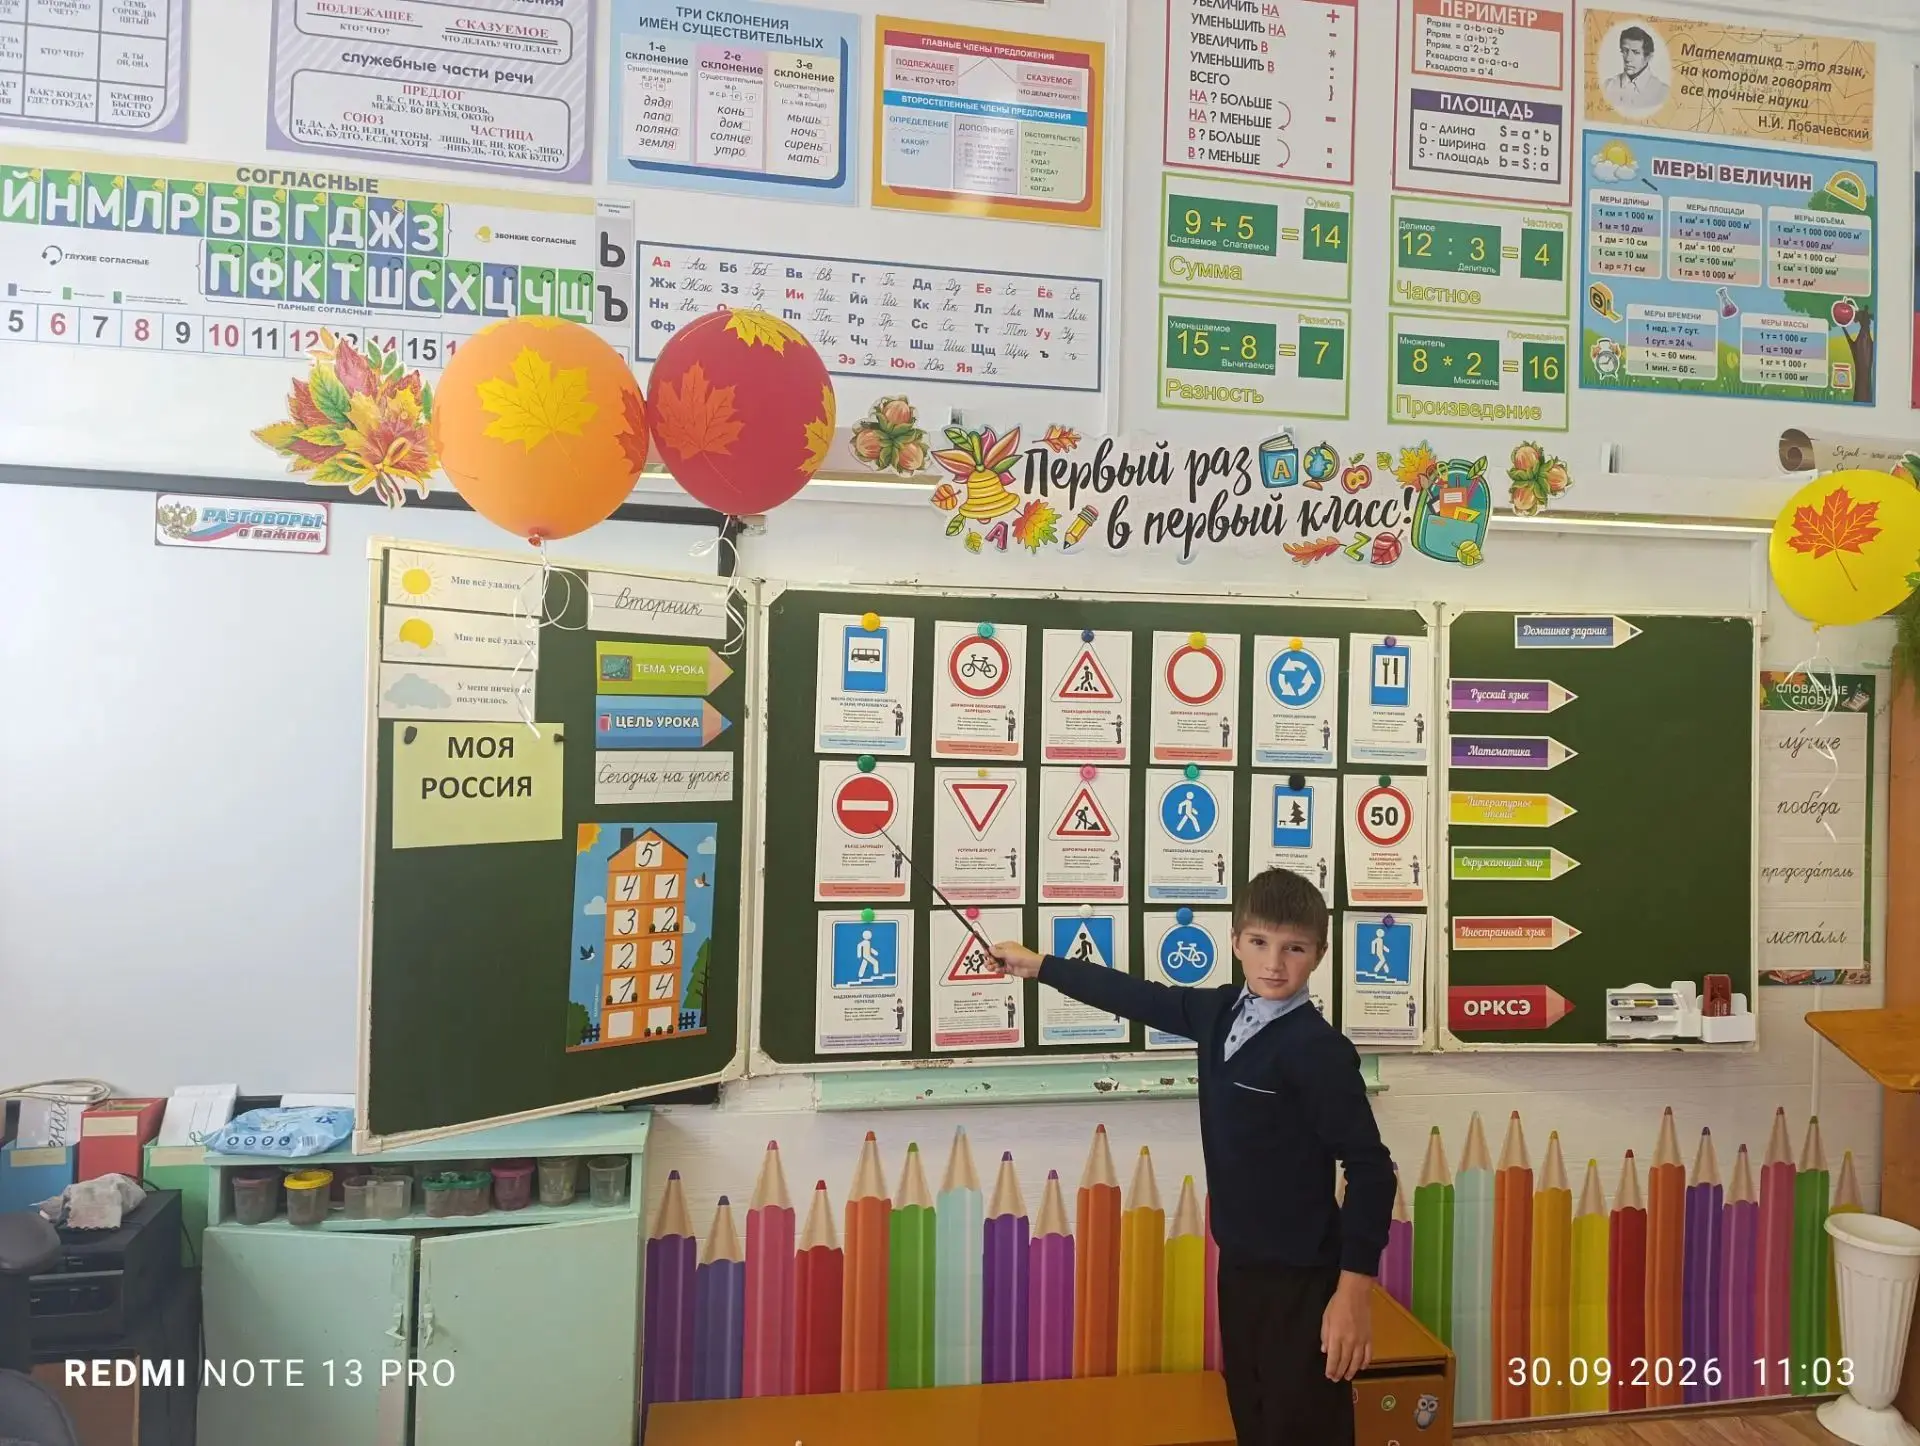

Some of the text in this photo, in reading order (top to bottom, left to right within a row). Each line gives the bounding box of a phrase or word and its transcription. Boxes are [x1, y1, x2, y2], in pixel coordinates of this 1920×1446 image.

[676, 6, 789, 30] ТРИ СКЛОНЕНИЯ
[1440, 0, 1538, 27] ПЕРИМЕТР
[639, 16, 823, 49] ИМЁН СУЩЕСТВИТЕЛЬНЫХ
[1190, 13, 1286, 37] УМЕНЬШИТЬ НА
[649, 42, 666, 52] 1-е
[922, 38, 1055, 60] ГЛАВНЫЕ ЧЛЕНЫ ПРЕДЛОЖЕНИЯ
[1190, 32, 1268, 52] УВЕЛИЧИТЬ В
[625, 52, 689, 66] склонение
[724, 51, 741, 62] 2-е
[796, 59, 813, 70] 3-е
[1190, 51, 1274, 73] УМЕНЬШИТЬ В
[1681, 43, 1867, 80] Математика это язык,
[342, 51, 534, 85] служебные части речи
[701, 60, 763, 75] склонение
[774, 69, 835, 83] склонение
[1190, 71, 1230, 86] ВСЕГО
[1681, 64, 1831, 96] на котором говорят
[110, 92, 153, 102] КРАСИВО
[402, 84, 466, 100] ПРЕДЛОГ
[1680, 84, 1808, 111] все точные науки
[112, 101, 151, 110] БЫСТРО
[644, 95, 671, 109] дядя
[902, 95, 1071, 121] ВТОРОСТЕПЕННЫЕ ЧЛЕНЫ ПРЕДЛОЖЕНИЯ
[1440, 93, 1534, 120] ПЛОЩАДЬ
[112, 109, 150, 118] ДАЛЕКО
[343, 112, 384, 124] СОЮЗ
[643, 110, 671, 122] папа
[717, 106, 744, 116] конь
[787, 114, 821, 125] мышь
[635, 123, 678, 136] поляна
[719, 117, 742, 130] дом
[1758, 115, 1869, 140] Н.И. Лобачевский
[470, 124, 534, 141] ЧАСТИЦА
[710, 132, 751, 144] солнце
[791, 128, 817, 138] ночь
[639, 137, 675, 149] земля
[714, 146, 746, 157] утро
[784, 140, 823, 151] сирень
[787, 152, 819, 164] мать
[236, 167, 379, 194] СОГЛАСНЫЕ
[1652, 160, 1812, 190] МЕРЫ ВЕЛИЧИН
[1600, 195, 1649, 206] МЕРЫ ДЛИНЫ
[1686, 204, 1744, 216] МЕРЫ ПЛОЩАДИ
[1185, 210, 1253, 240] 9 5
[495, 232, 576, 245] ЗВОНКИЕ СОГЛАСНЫЕ
[1170, 234, 1270, 252] Слагаемое Слагаемое
[1311, 225, 1340, 249] 14
[1403, 232, 1485, 261] 12 3
[1534, 244, 1550, 266] 4
[65, 252, 149, 266] ГЛУХИЕ СОГЛАСНЫЕ
[1169, 256, 1242, 281] Сумма
[1397, 280, 1481, 305] Частное
[277, 303, 373, 316] ПАРНЫЕ СОГЛАСНЫЕ
[8, 310, 437, 360] 5 6 7 8 9 10 11 15
[1400, 337, 1445, 349] Множитель
[1177, 332, 1257, 359] 15 8
[1314, 341, 1329, 365] 7
[1221, 359, 1274, 370] Вычитаемое
[1413, 349, 1482, 376] 8 2
[1529, 356, 1559, 380] 16
[1165, 378, 1264, 404] Разность
[1396, 395, 1542, 421] Произведение
[1023, 438, 1252, 510] Первый раз
[202, 508, 324, 528] РАЗГОВОРЫ
[1107, 487, 1417, 558] в первый класс!
[238, 528, 320, 541] о важном
[451, 576, 521, 592] Мне всё удалось
[614, 587, 703, 620] Вторник
[1522, 624, 1608, 639] Домашнее задание
[636, 662, 705, 676] ТЕМА УРОКА
[457, 695, 507, 706] получилось
[1470, 688, 1529, 703] Русский язык
[1791, 695, 1833, 706] СЛОВА
[615, 715, 699, 730] ЦЕЛЬ УРОКА
[448, 736, 515, 759] МОЯ
[1468, 746, 1531, 757] Математика
[421, 775, 532, 800] РОССИЯ
[599, 766, 730, 792] Сегодня на уроке
[1370, 807, 1398, 826] 50
[638, 842, 661, 867] 5
[1461, 856, 1543, 871] Окружающий мир
[622, 874, 676, 901] 4 1
[618, 906, 675, 935] 3 2
[1461, 925, 1546, 939] Иностранный язык
[617, 939, 673, 969] 2 3
[620, 976, 635, 1003] 1
[655, 974, 673, 999] 4
[1464, 1000, 1531, 1016] ОРКСЭ
